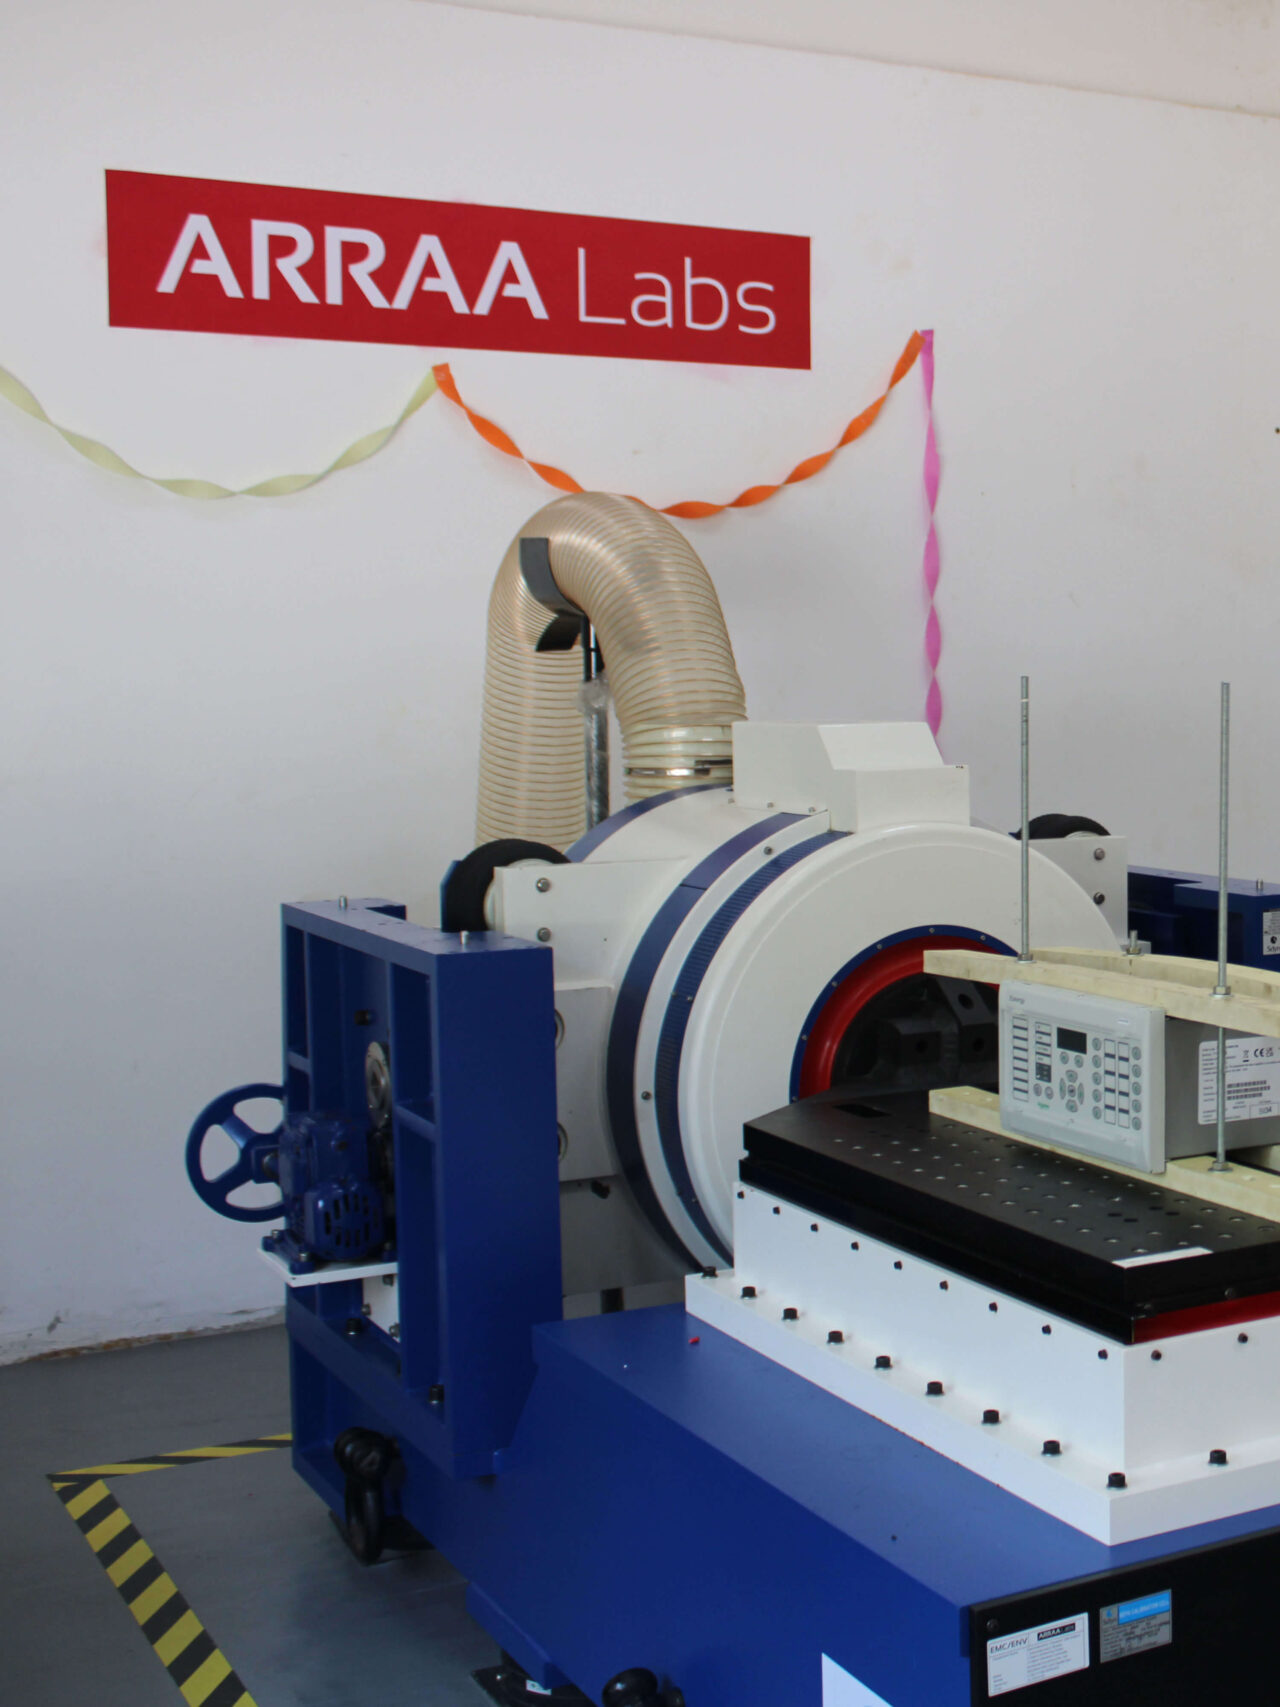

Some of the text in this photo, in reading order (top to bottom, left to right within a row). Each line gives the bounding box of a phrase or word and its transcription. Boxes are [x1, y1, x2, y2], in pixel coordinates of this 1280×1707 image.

[156, 213, 776, 335] ARRAA Labs
[990, 1637, 1028, 1654] EMC/ENV
